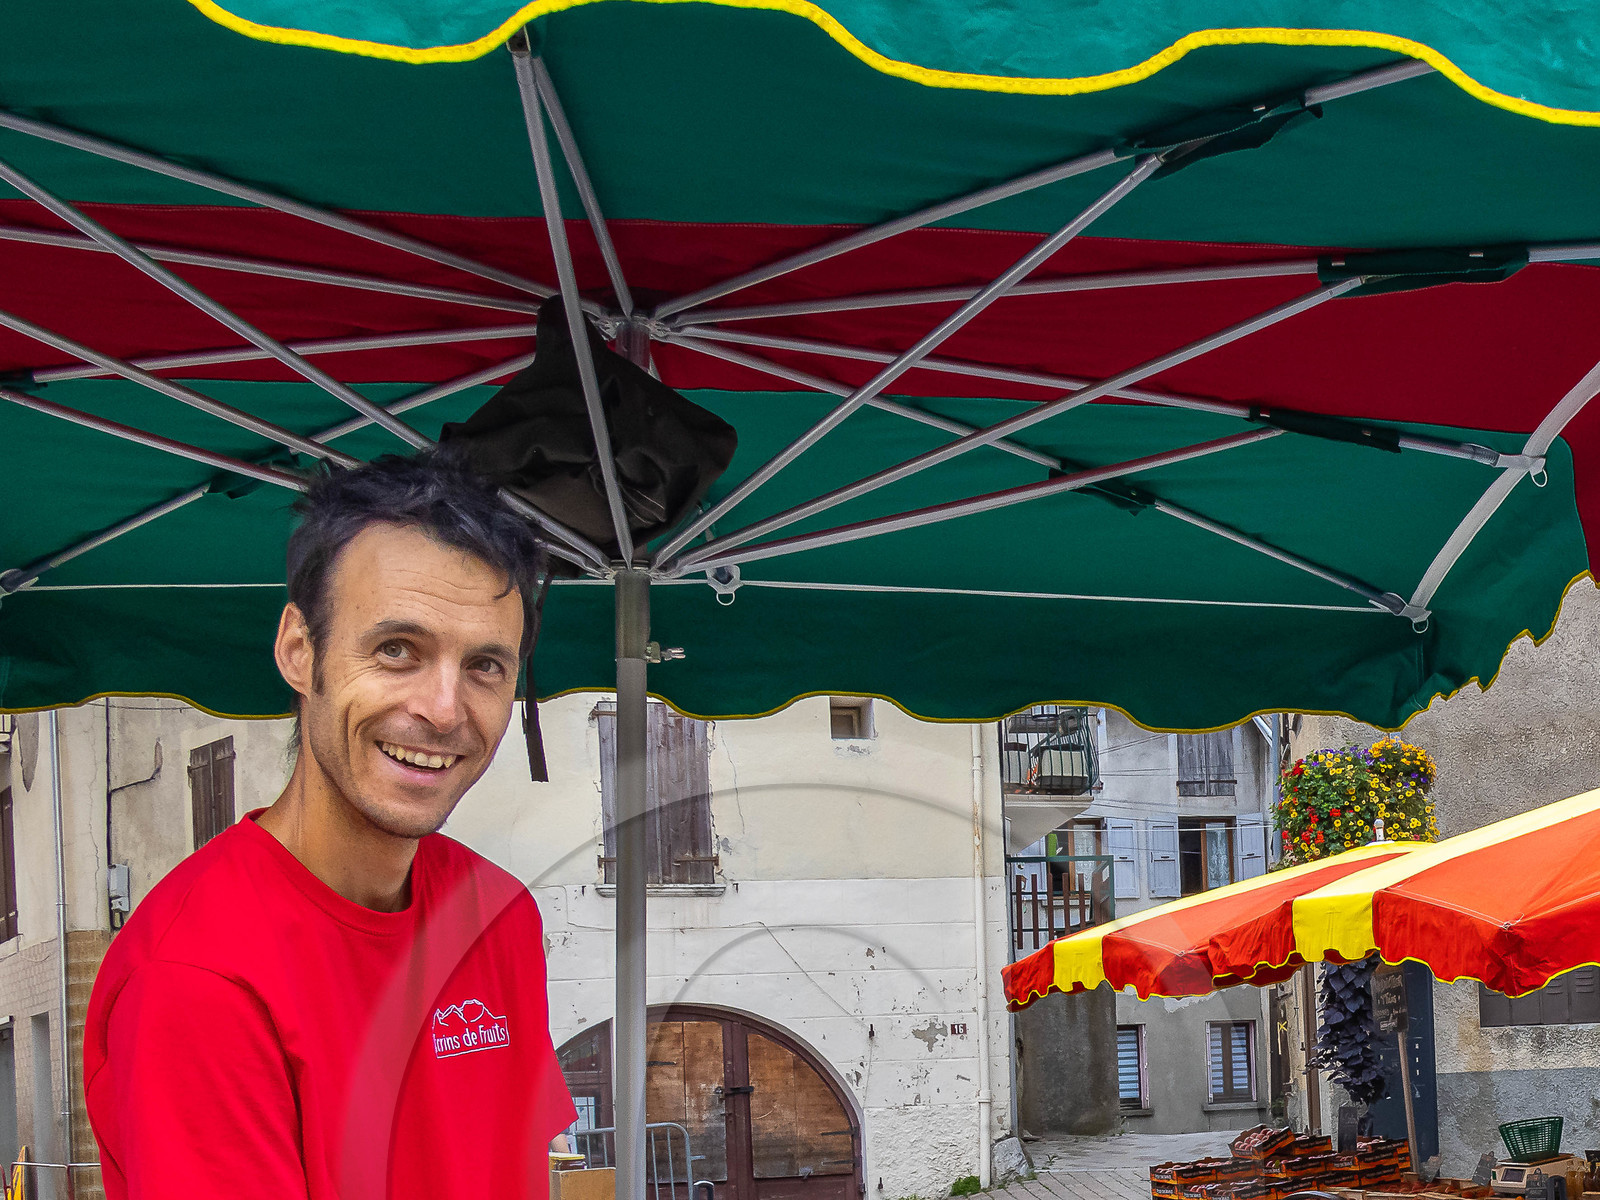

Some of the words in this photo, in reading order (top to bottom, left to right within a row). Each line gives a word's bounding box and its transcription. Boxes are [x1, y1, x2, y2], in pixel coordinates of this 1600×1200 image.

[462, 1028, 478, 1047] de
[479, 1023, 506, 1044] Fruits
[955, 1024, 964, 1034] 16
